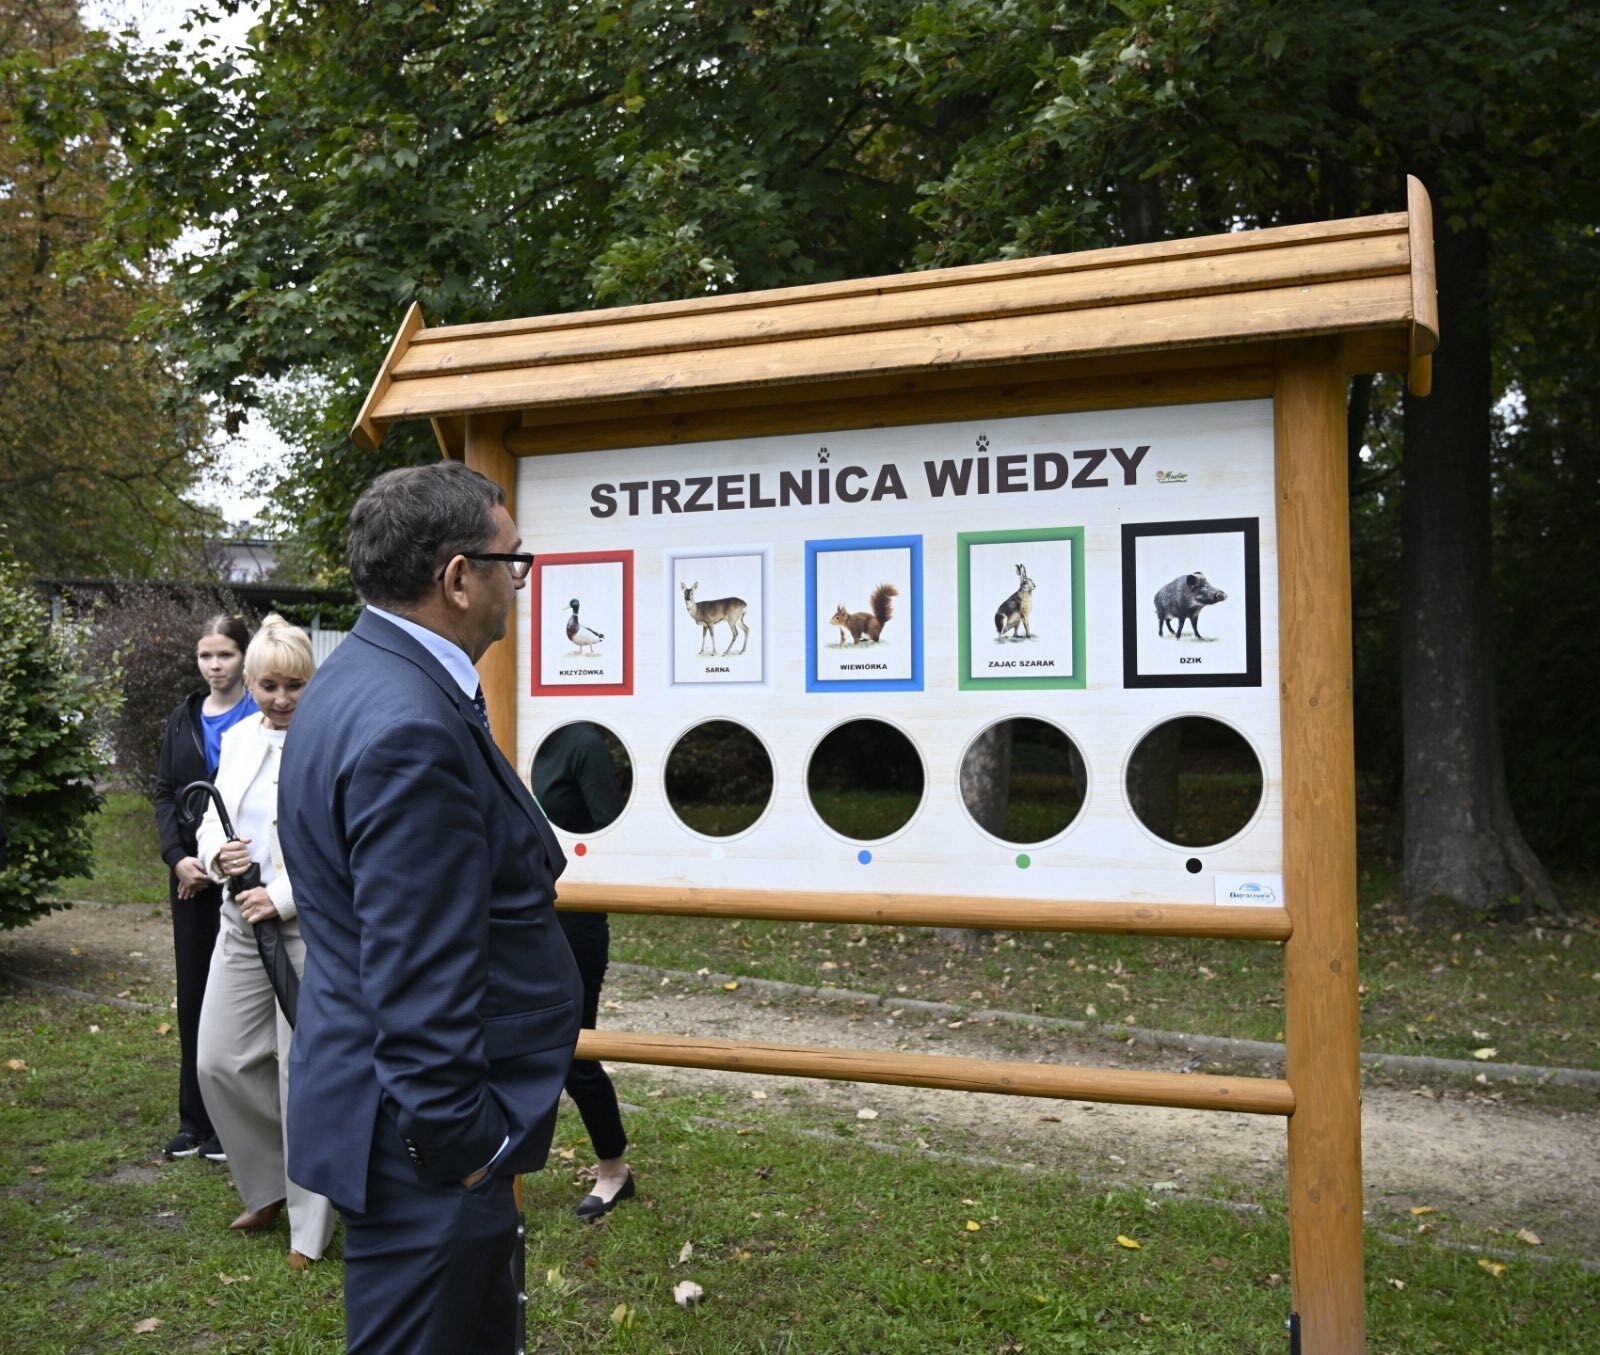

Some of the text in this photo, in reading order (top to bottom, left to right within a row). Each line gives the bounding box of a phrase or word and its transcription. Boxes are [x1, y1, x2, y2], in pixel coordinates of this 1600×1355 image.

[589, 445, 1151, 518] STRZELNICA WIEDZY
[840, 662, 888, 671] WIEWIÓRKA
[988, 661, 1017, 669] ZAJĄC
